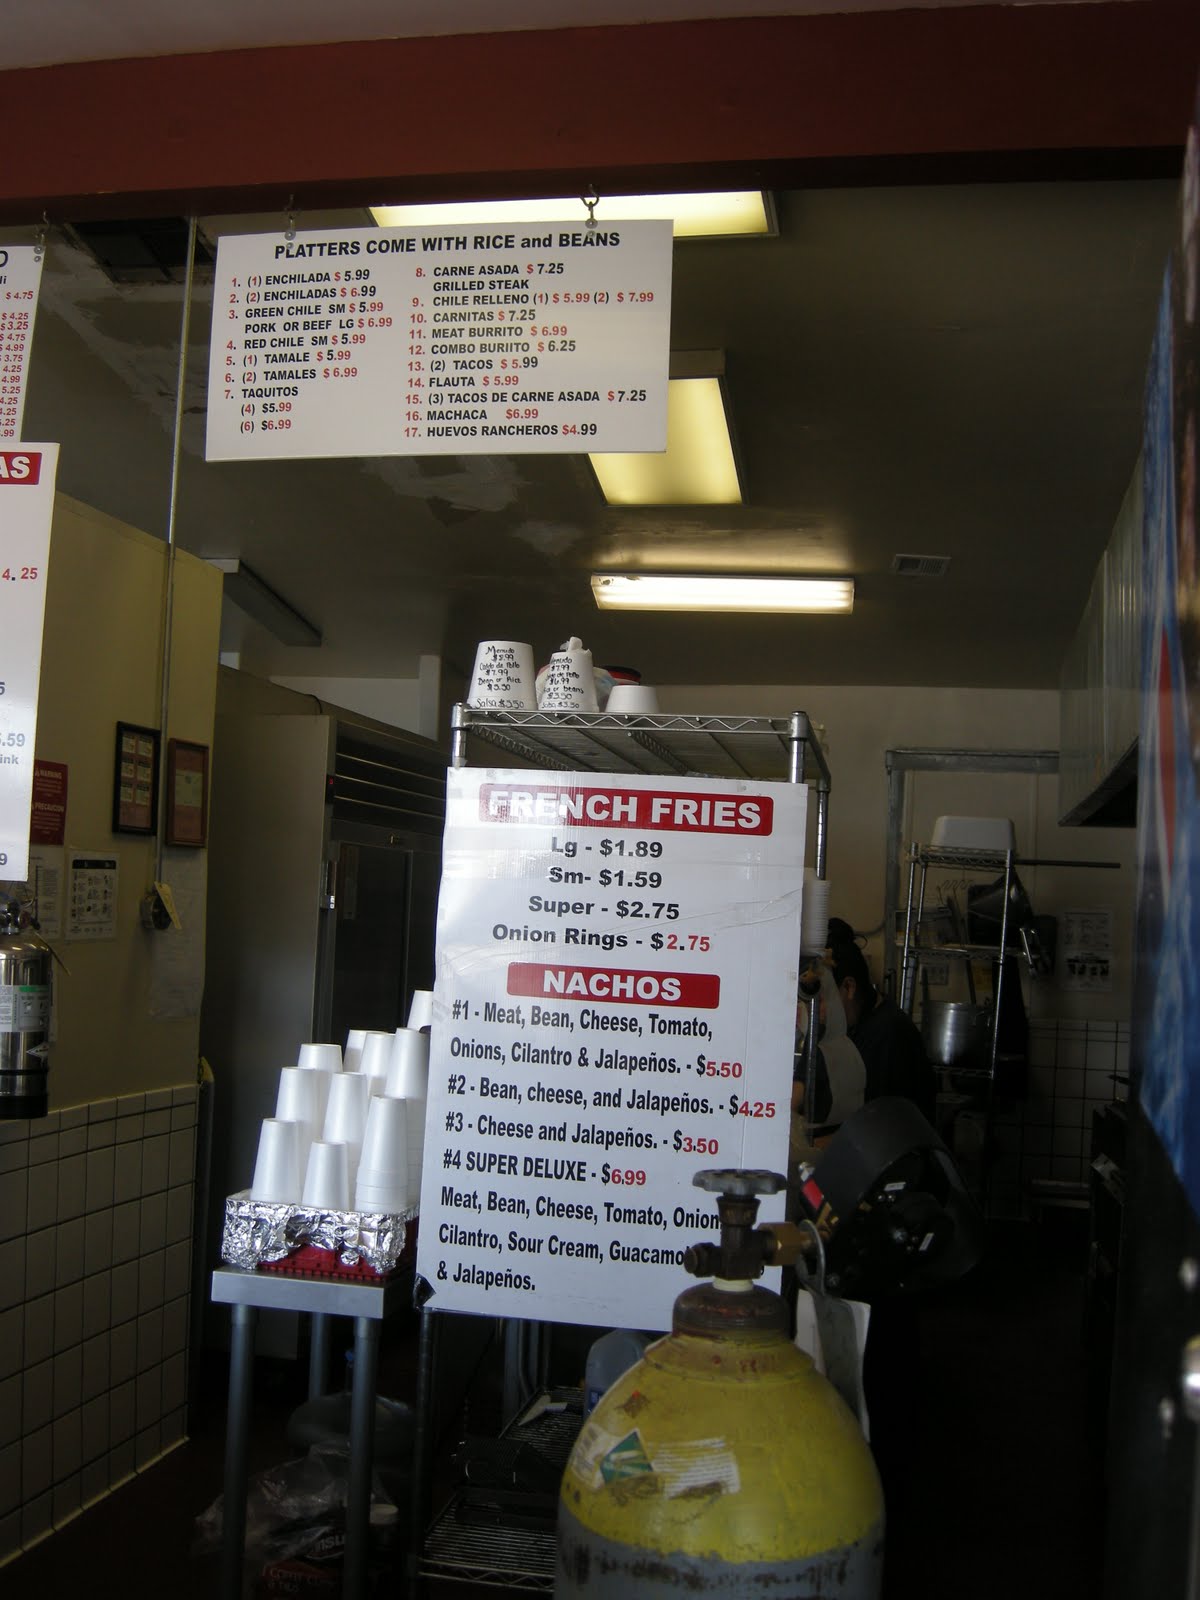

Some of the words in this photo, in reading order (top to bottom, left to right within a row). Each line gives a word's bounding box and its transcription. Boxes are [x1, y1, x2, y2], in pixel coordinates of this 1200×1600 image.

[275, 241, 360, 259] PLATTERS
[366, 239, 416, 254] COME
[422, 237, 467, 251] WITH
[474, 235, 515, 249] RICE
[521, 234, 552, 248] and
[559, 232, 620, 247] BEANS
[416, 268, 425, 277] 8.
[434, 266, 474, 276] CARNE
[479, 265, 519, 275] ASADA
[232, 278, 240, 287] 1.
[248, 276, 261, 288] (1)
[266, 273, 330, 285] ENCHILADA
[433, 281, 484, 291] GRILLED
[489, 280, 529, 290] STEAK
[230, 294, 239, 303] 2.
[246, 292, 260, 304] (2)
[264, 288, 336, 301] ENCHILADAS
[413, 298, 423, 307] 9.
[433, 296, 469, 306] CHILE
[473, 294, 529, 305] RELLENO
[533, 293, 548, 305] (1)
[594, 292, 609, 304] (2)
[229, 310, 238, 319] 3.
[245, 307, 283, 318] GREEN
[288, 305, 321, 316] CHILE
[329, 304, 345, 314] SM
[411, 314, 427, 323] 10.
[433, 311, 494, 322] CARNITAS
[245, 323, 276, 333] PORK
[283, 322, 299, 331] OR
[303, 320, 332, 330] BEEF
[339, 319, 354, 329] LG
[410, 329, 426, 339] 11.
[432, 328, 465, 338] MEAT
[469, 327, 523, 337] BURRITO
[227, 341, 236, 350] 4.
[245, 339, 266, 349] RED
[270, 337, 304, 347] CHILE
[311, 336, 327, 346] SM
[409, 345, 425, 355] 12.
[431, 344, 475, 354] COMBO
[226, 356, 235, 366] 5.
[243, 355, 257, 367] (1)
[265, 352, 309, 363] TAMALE
[408, 361, 424, 371] 13.
[431, 360, 445, 372] (2)
[453, 360, 493, 370] TACOS
[225, 373, 234, 383] 6.
[243, 372, 256, 384] (2)
[264, 369, 316, 380] TAMALES
[408, 378, 424, 388] 14.
[429, 377, 475, 387] FLAUTA
[225, 390, 234, 399] 7.
[242, 387, 298, 398] TAQUITOS
[406, 394, 422, 404] 15.
[429, 393, 443, 405] (3)
[448, 393, 487, 403] TACOS
[492, 393, 507, 402] DE
[512, 392, 554, 402] CARNE
[558, 391, 599, 401] ASADA
[241, 404, 255, 416] (4)
[262, 402, 291, 413] $5.99
[406, 411, 422, 421] 16.
[427, 410, 487, 420] MACHACA
[506, 409, 538, 419] $6.99
[240, 421, 254, 434] (6)
[261, 419, 291, 431] $6.99
[405, 427, 421, 437] 17.
[428, 426, 477, 437] HUEVOS
[482, 425, 558, 435] RANCHEROS
[562, 424, 597, 435] $4.99
[489, 790, 638, 823] FRENCH
[651, 797, 761, 830] FRIES
[552, 837, 577, 857] Lg
[600, 839, 662, 858] $1.89
[599, 869, 662, 888] $1.59
[529, 896, 595, 917] Super
[616, 900, 679, 919] $2.75
[493, 924, 556, 943] Onion
[565, 928, 628, 950] Rings
[543, 969, 682, 1001] NACHOS
[453, 1000, 468, 1020] #1
[484, 1002, 525, 1029] Meat,
[531, 1006, 574, 1032] Bean,
[580, 1009, 642, 1037] Cheese,
[649, 1014, 712, 1041] Tomato,
[451, 1037, 505, 1065] Onions,
[512, 1042, 572, 1066] Cilantro
[578, 1047, 589, 1067] &
[595, 1049, 680, 1075] Jalapeños.
[696, 1054, 742, 1078] $5.50
[448, 1074, 465, 1095] #2
[480, 1077, 521, 1104] Bean,
[528, 1082, 587, 1110] cheese,
[593, 1088, 621, 1108] and
[627, 1089, 713, 1116] Jalapeños.
[729, 1094, 775, 1118] $4.25
[446, 1111, 463, 1132] #3
[478, 1115, 533, 1139] Cheese
[538, 1122, 566, 1142] and
[572, 1123, 657, 1150] Jalapeños.
[673, 1129, 718, 1155] $3.50
[444, 1149, 461, 1169] #4
[466, 1151, 518, 1175] SUPER
[523, 1157, 586, 1181] DELUXE
[601, 1163, 646, 1185] $6.99
[441, 1186, 481, 1214] Meat,
[488, 1191, 530, 1219] Bean,
[536, 1196, 597, 1225] Cheese,
[604, 1202, 667, 1230] Tomato,
[439, 1224, 502, 1254] Cilantro,
[508, 1231, 544, 1253] Sour
[548, 1235, 603, 1264] Cream,
[437, 1261, 447, 1280] &
[453, 1263, 535, 1290] Jalapeños.
